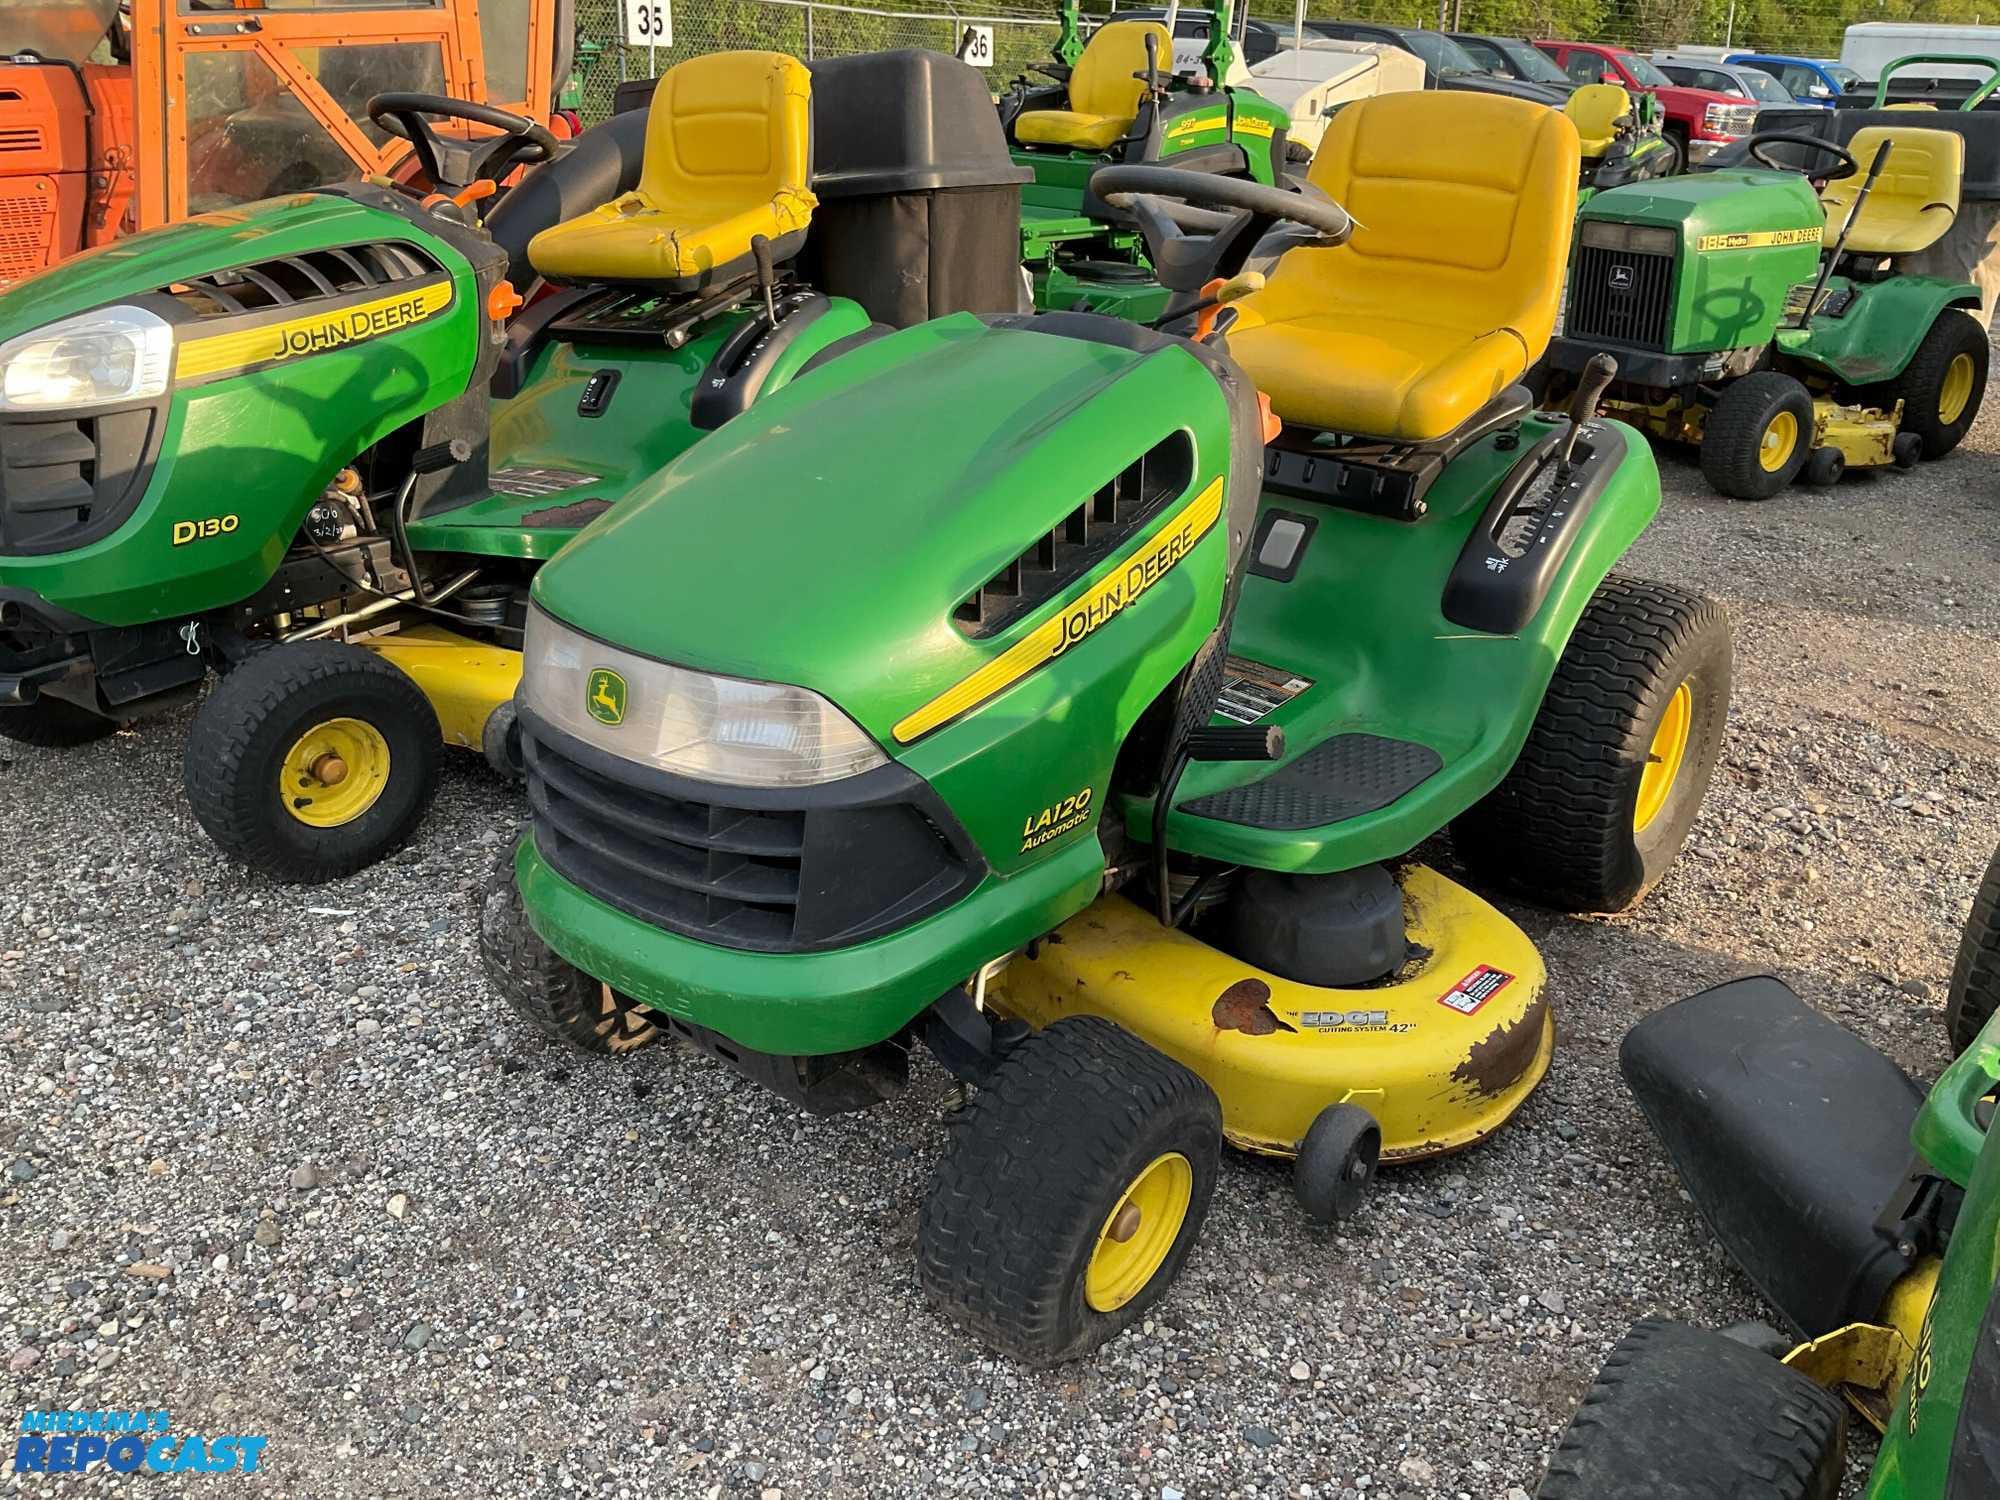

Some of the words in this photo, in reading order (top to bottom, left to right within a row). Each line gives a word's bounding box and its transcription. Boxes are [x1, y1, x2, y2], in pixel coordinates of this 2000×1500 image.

[638, 5, 663, 36] 35
[971, 34, 988, 58] 36
[1770, 230, 1794, 244] JOHN
[1797, 228, 1821, 241] DEERE
[274, 320, 348, 358] JOHN
[350, 297, 426, 338] DEERE
[173, 514, 239, 546] D130
[1053, 584, 1121, 654] JOHN
[1126, 522, 1194, 598] DEERE
[1023, 787, 1092, 837] LA120
[1020, 809, 1091, 854] Automatic
[1301, 1010, 1389, 1028] EDGE
